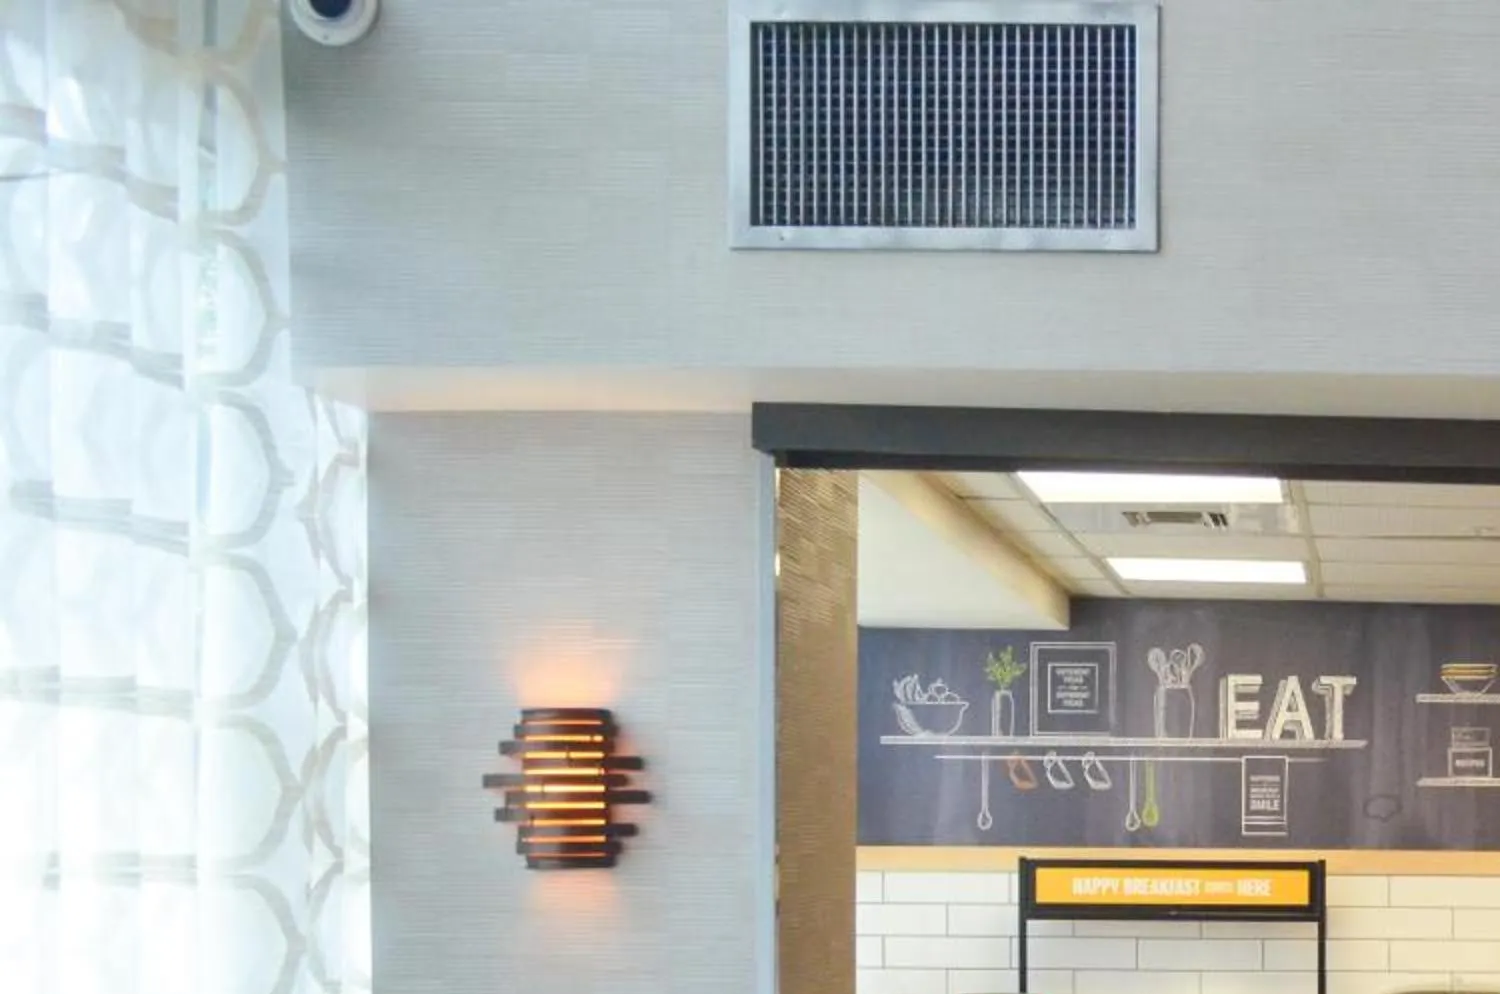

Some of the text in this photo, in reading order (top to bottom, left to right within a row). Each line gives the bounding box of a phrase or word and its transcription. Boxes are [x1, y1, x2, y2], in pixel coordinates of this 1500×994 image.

[1219, 674, 1357, 741] EAT
[1072, 877, 1120, 896] HAPPY
[1123, 877, 1200, 896] BREAKFAST
[1237, 879, 1272, 897] HERE
